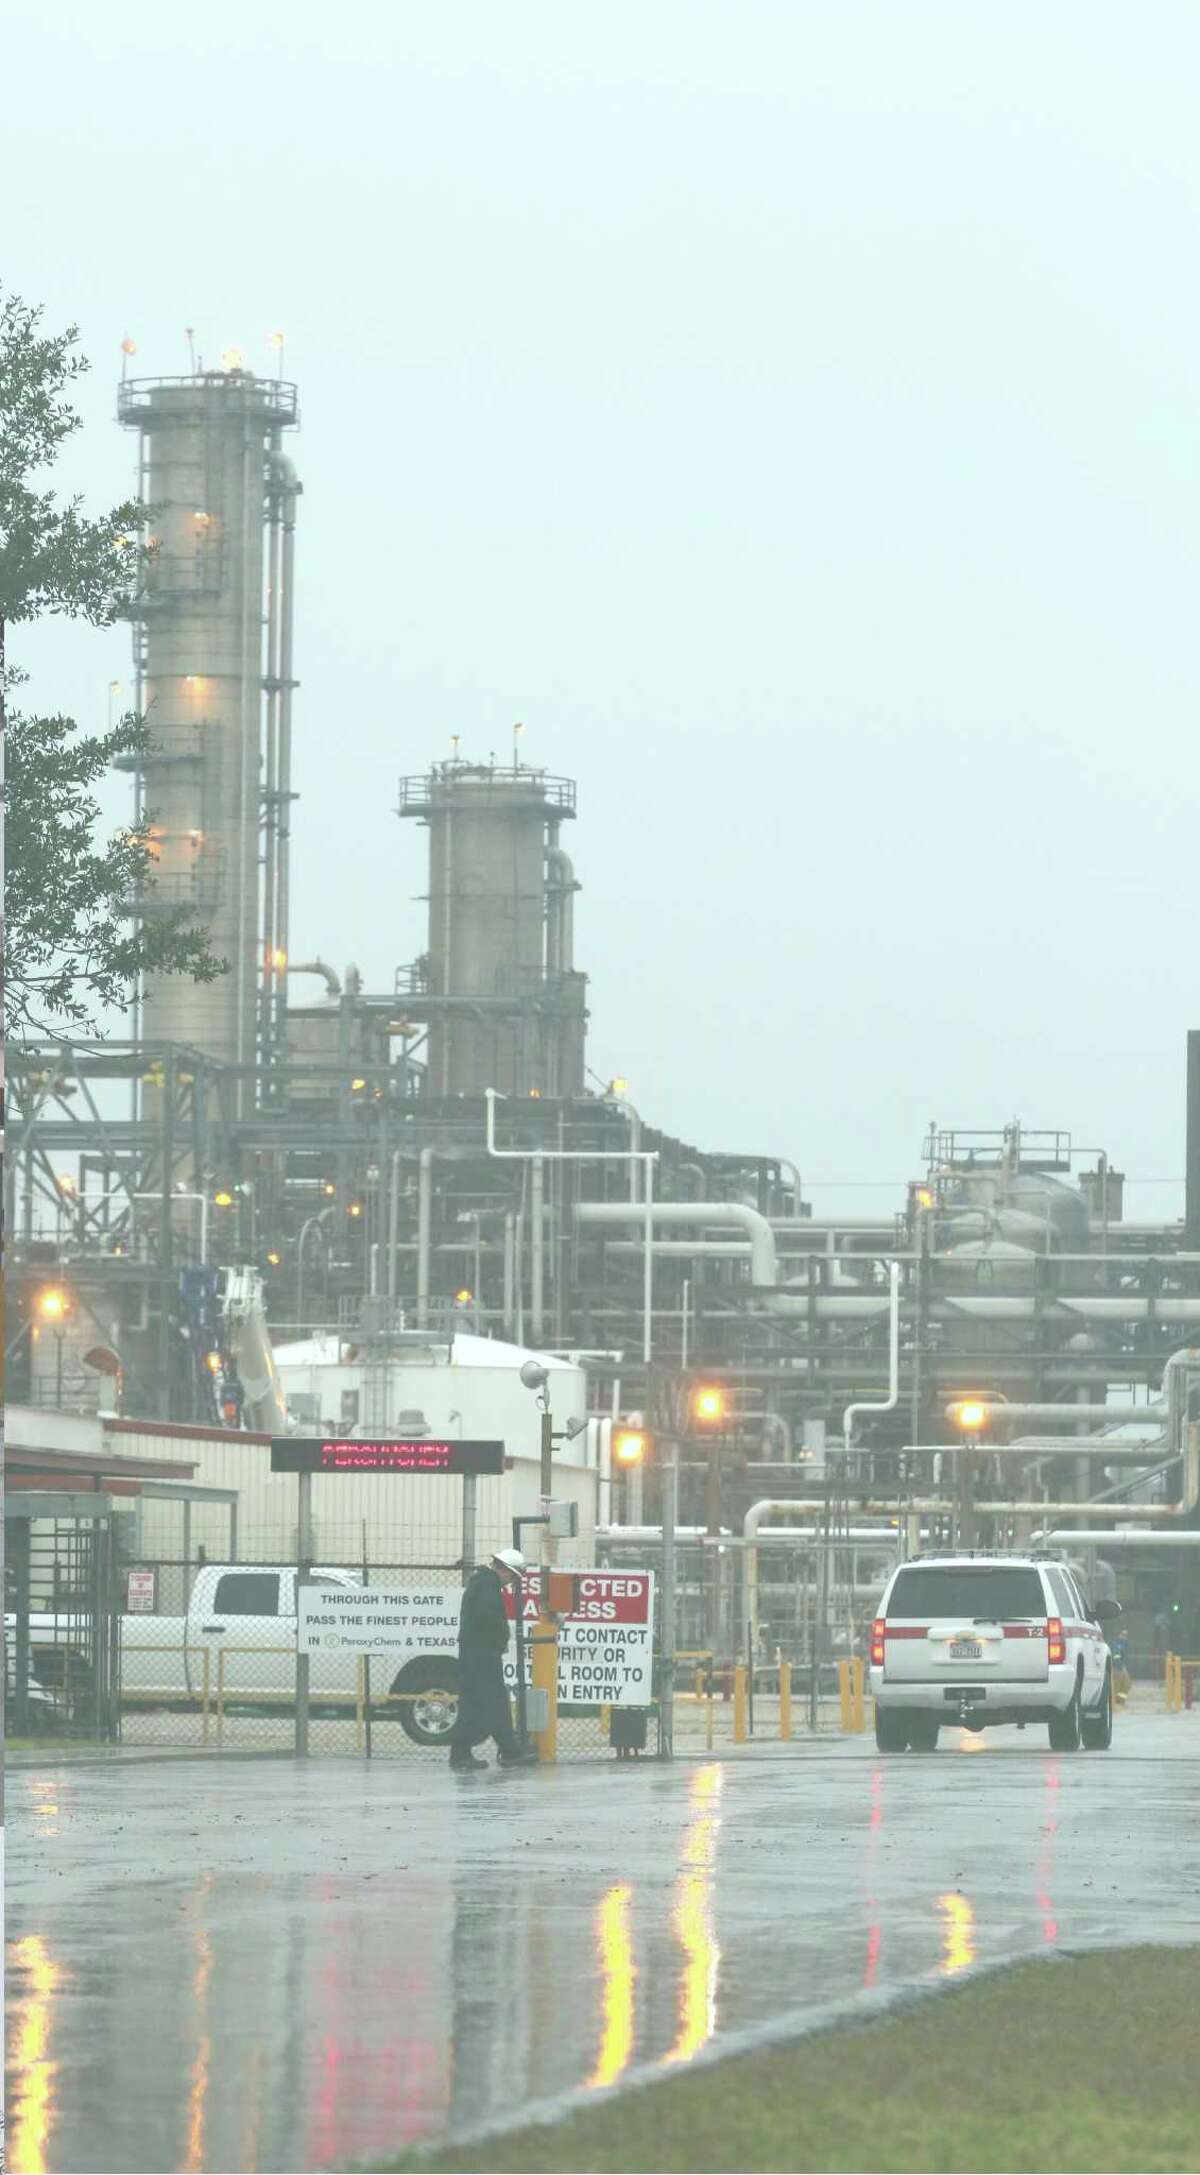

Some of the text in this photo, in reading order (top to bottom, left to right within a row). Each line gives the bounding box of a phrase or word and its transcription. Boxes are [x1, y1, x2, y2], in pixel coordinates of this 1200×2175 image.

[501, 1576, 643, 1597] ESCTED
[321, 1594, 444, 1606] THROUGH THIS GATE
[522, 1599, 617, 1619] AESS
[306, 1615, 458, 1626] PASS THE FINEST PEOPLE
[575, 1629, 648, 1645] CONTACT
[1026, 1627, 1044, 1637] T-2
[308, 1636, 320, 1646] IN
[341, 1636, 401, 1648] PeroxyChem
[406, 1636, 414, 1646] &
[604, 1648, 625, 1663] OR
[571, 1666, 618, 1681] ROOM
[622, 1667, 643, 1682] TO
[572, 1685, 623, 1700] ENTRY
